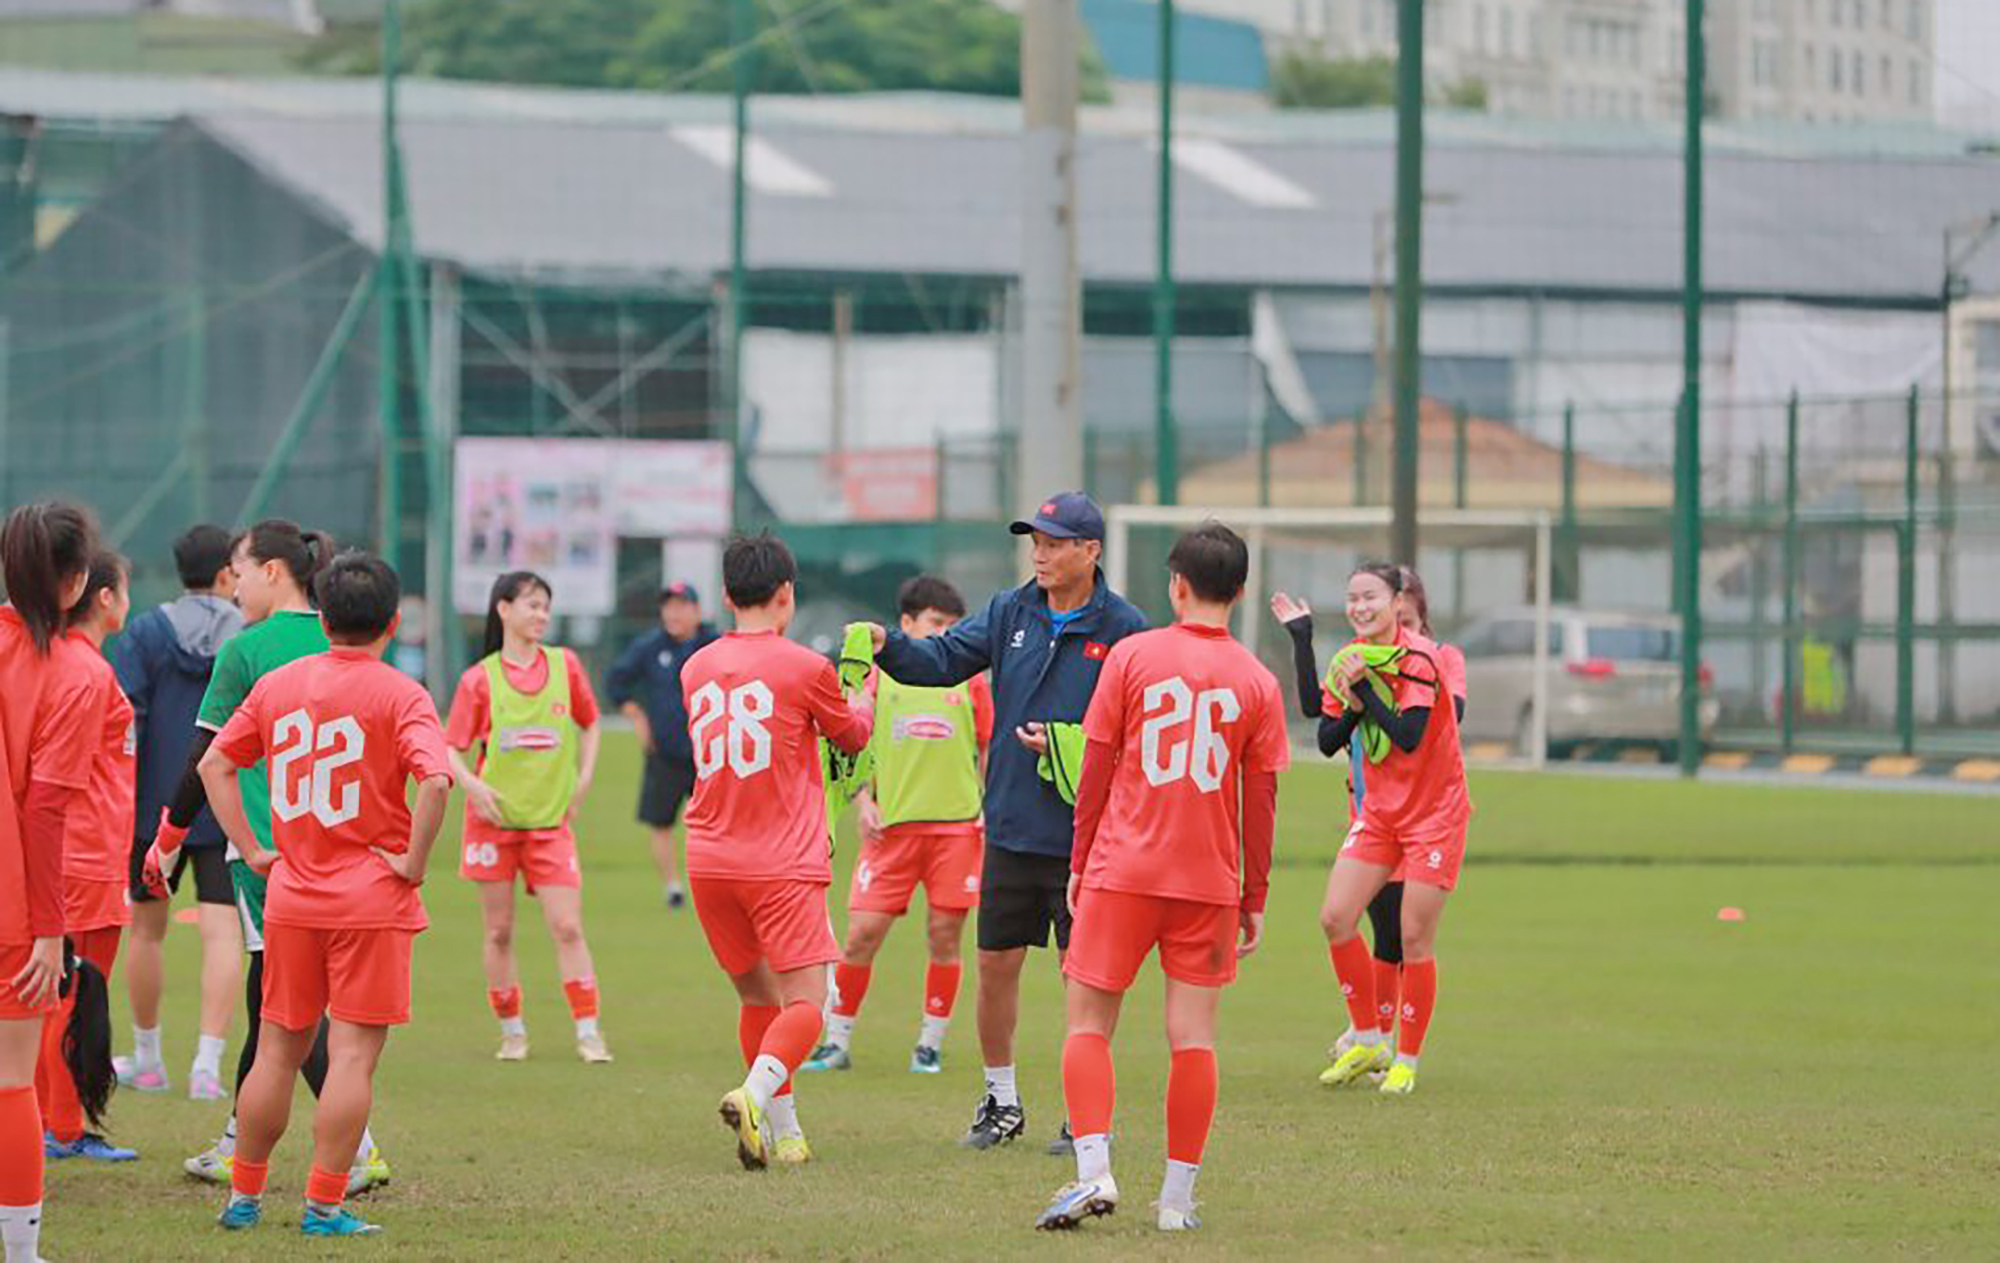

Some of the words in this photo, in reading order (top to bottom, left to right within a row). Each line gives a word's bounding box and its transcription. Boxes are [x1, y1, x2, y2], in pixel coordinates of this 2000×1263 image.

[270, 708, 365, 828] 22
[689, 679, 775, 780] 28
[1141, 676, 1241, 794] 26
